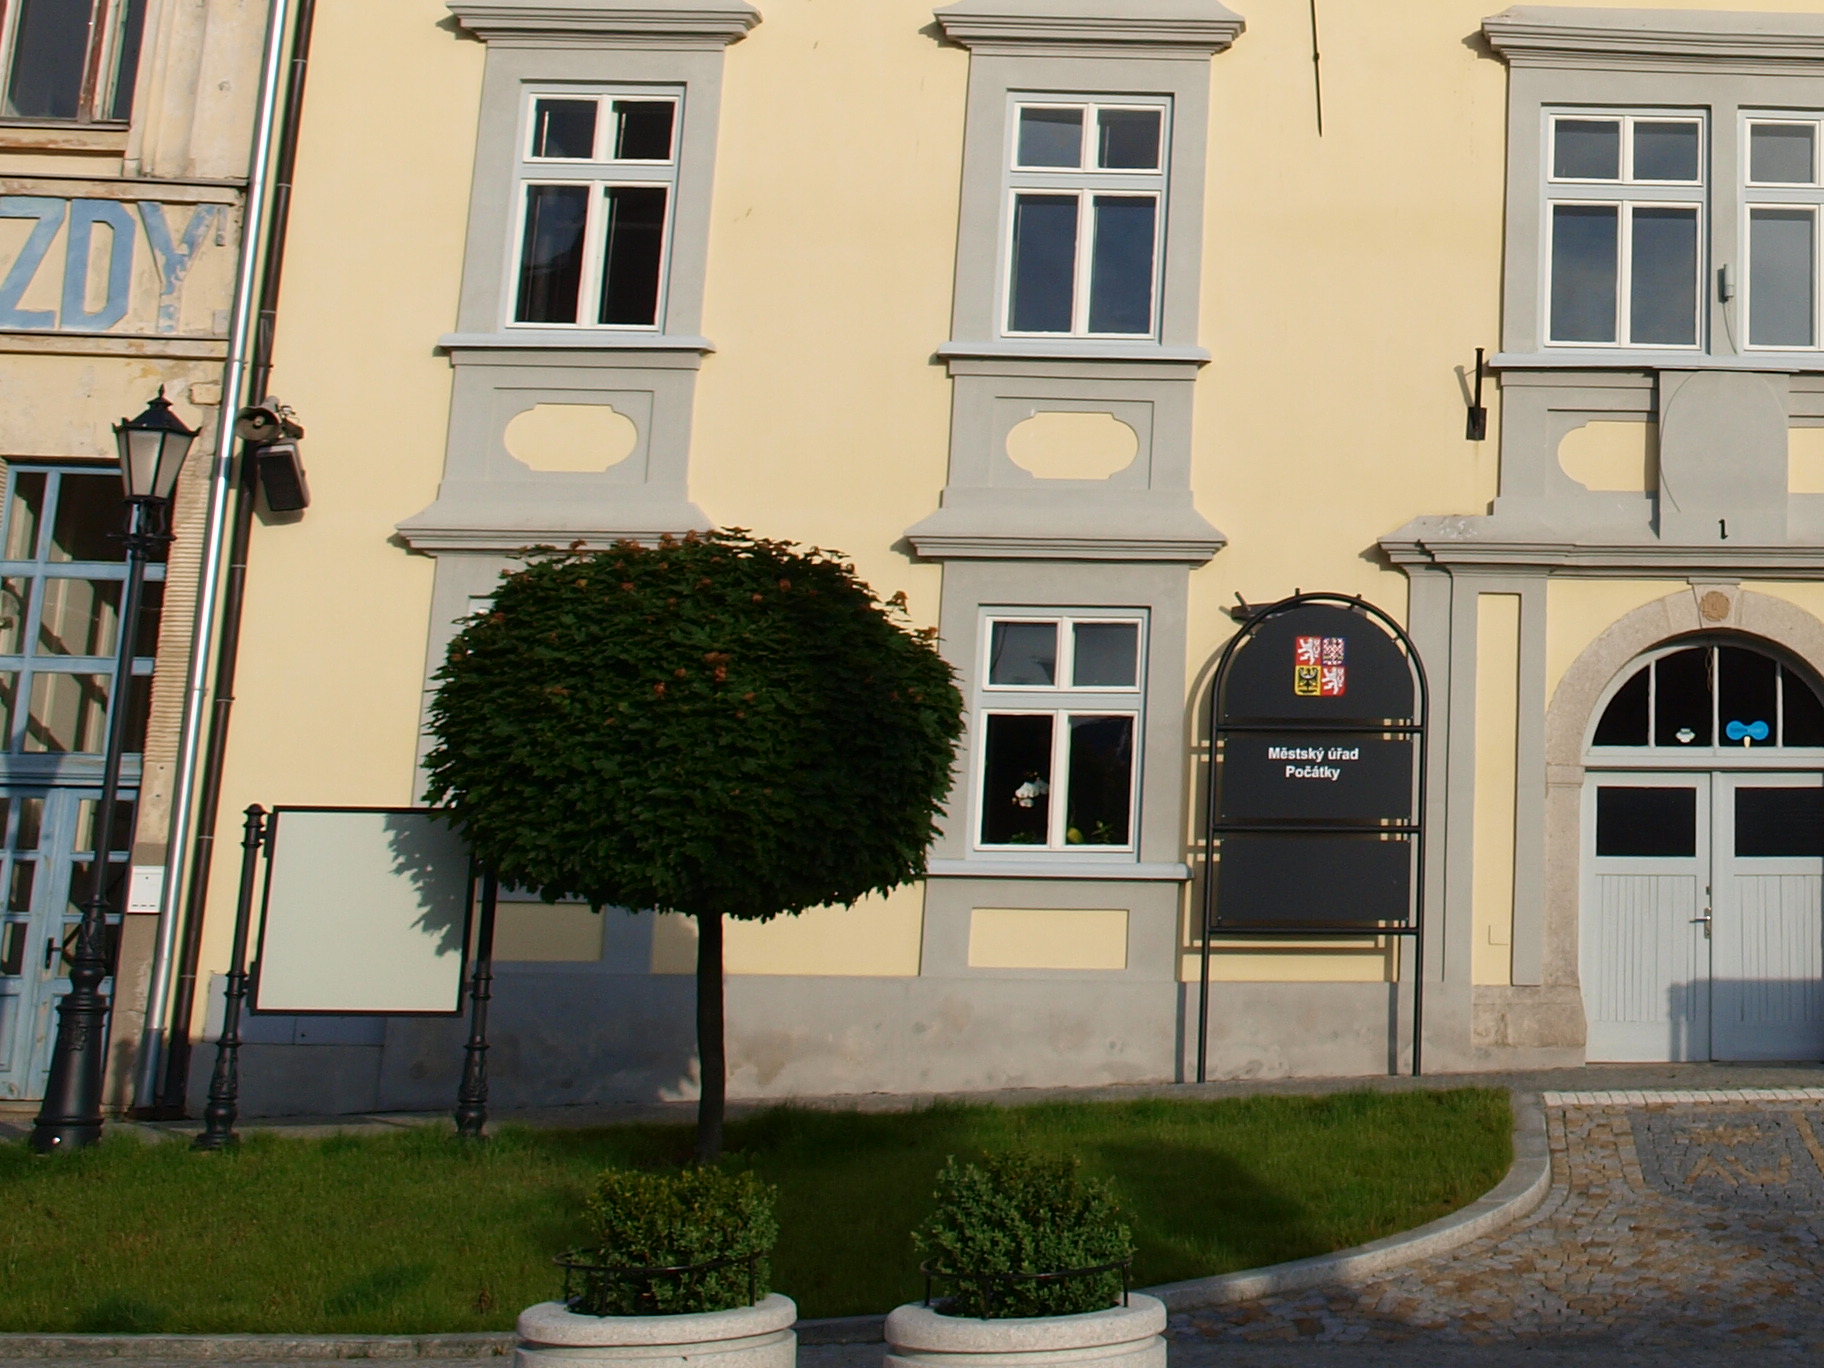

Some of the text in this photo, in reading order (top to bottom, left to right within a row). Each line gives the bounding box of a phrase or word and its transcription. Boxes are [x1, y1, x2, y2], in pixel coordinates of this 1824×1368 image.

[1267, 746, 1360, 763] Městský úřad
[1285, 764, 1341, 781] Počátky
